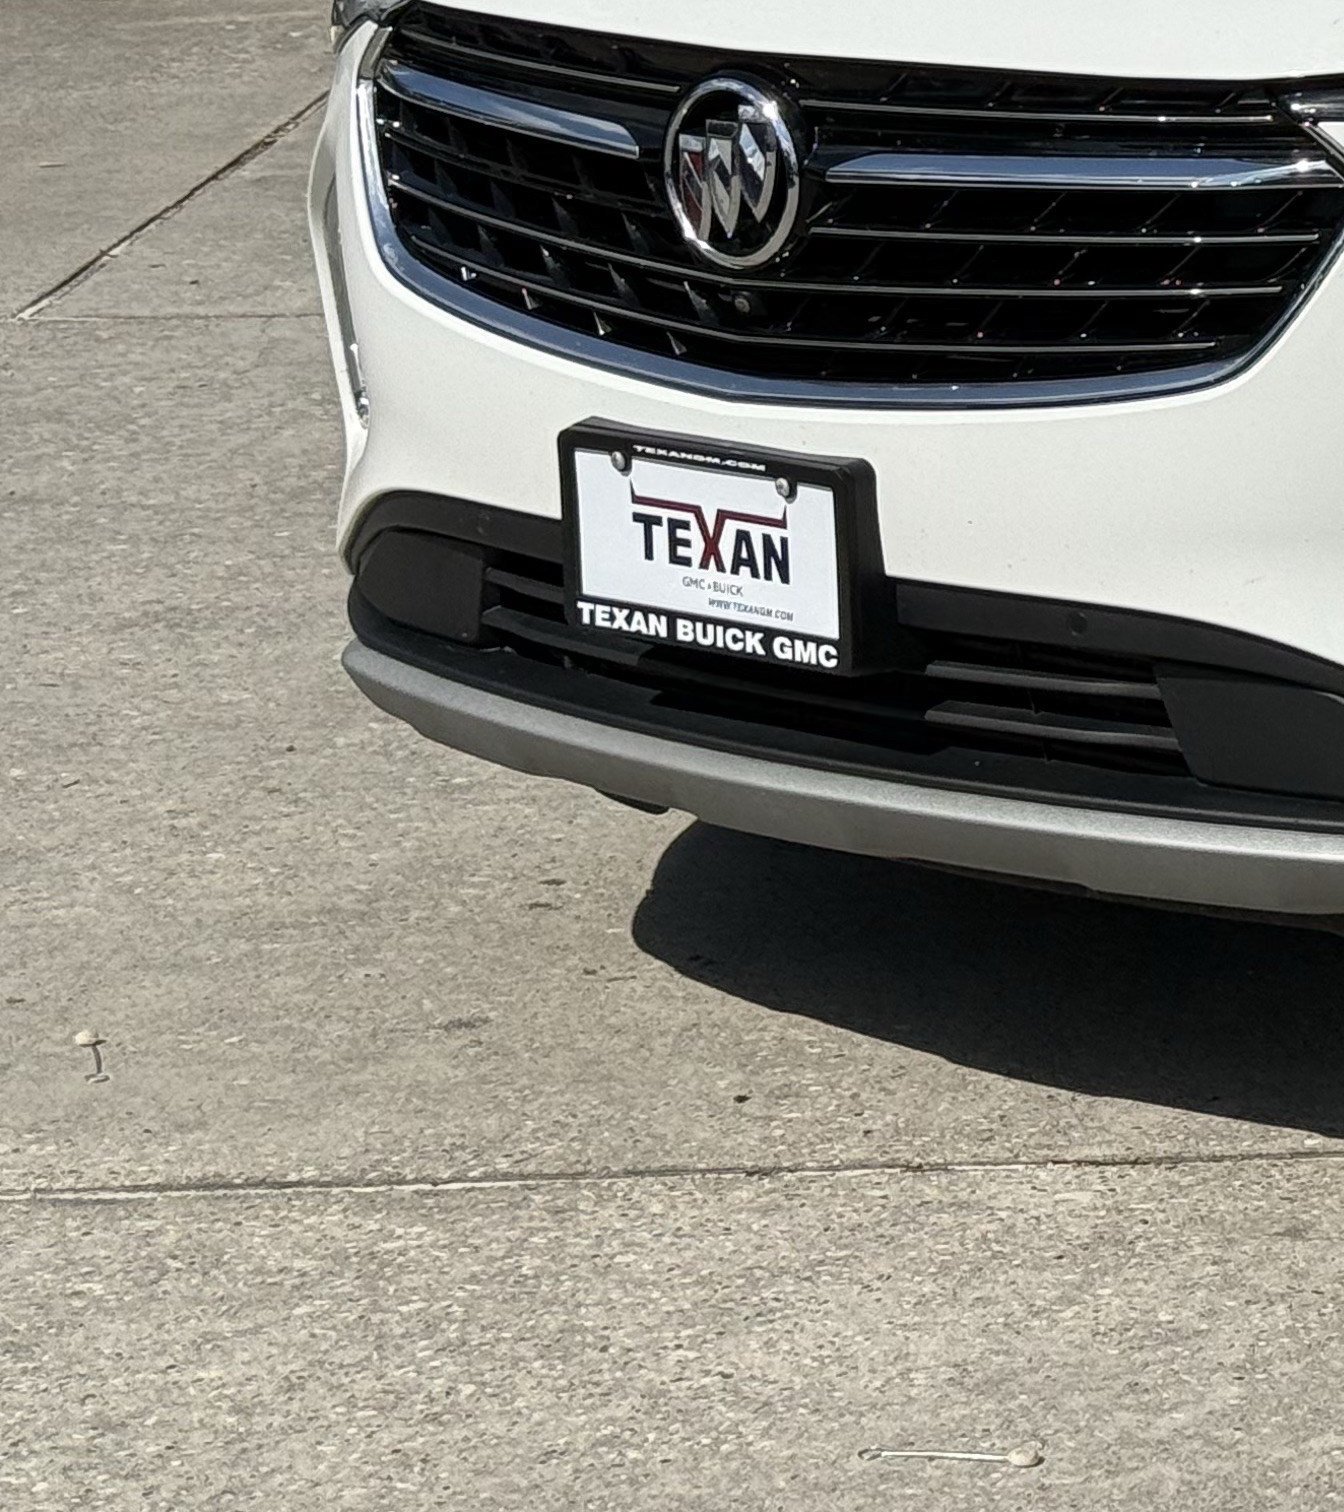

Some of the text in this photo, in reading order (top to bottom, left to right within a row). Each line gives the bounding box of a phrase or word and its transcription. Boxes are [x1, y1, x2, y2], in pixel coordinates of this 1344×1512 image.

[630, 478, 791, 585] TEXAN
[576, 600, 839, 669] TEXAN BUICK GMC
